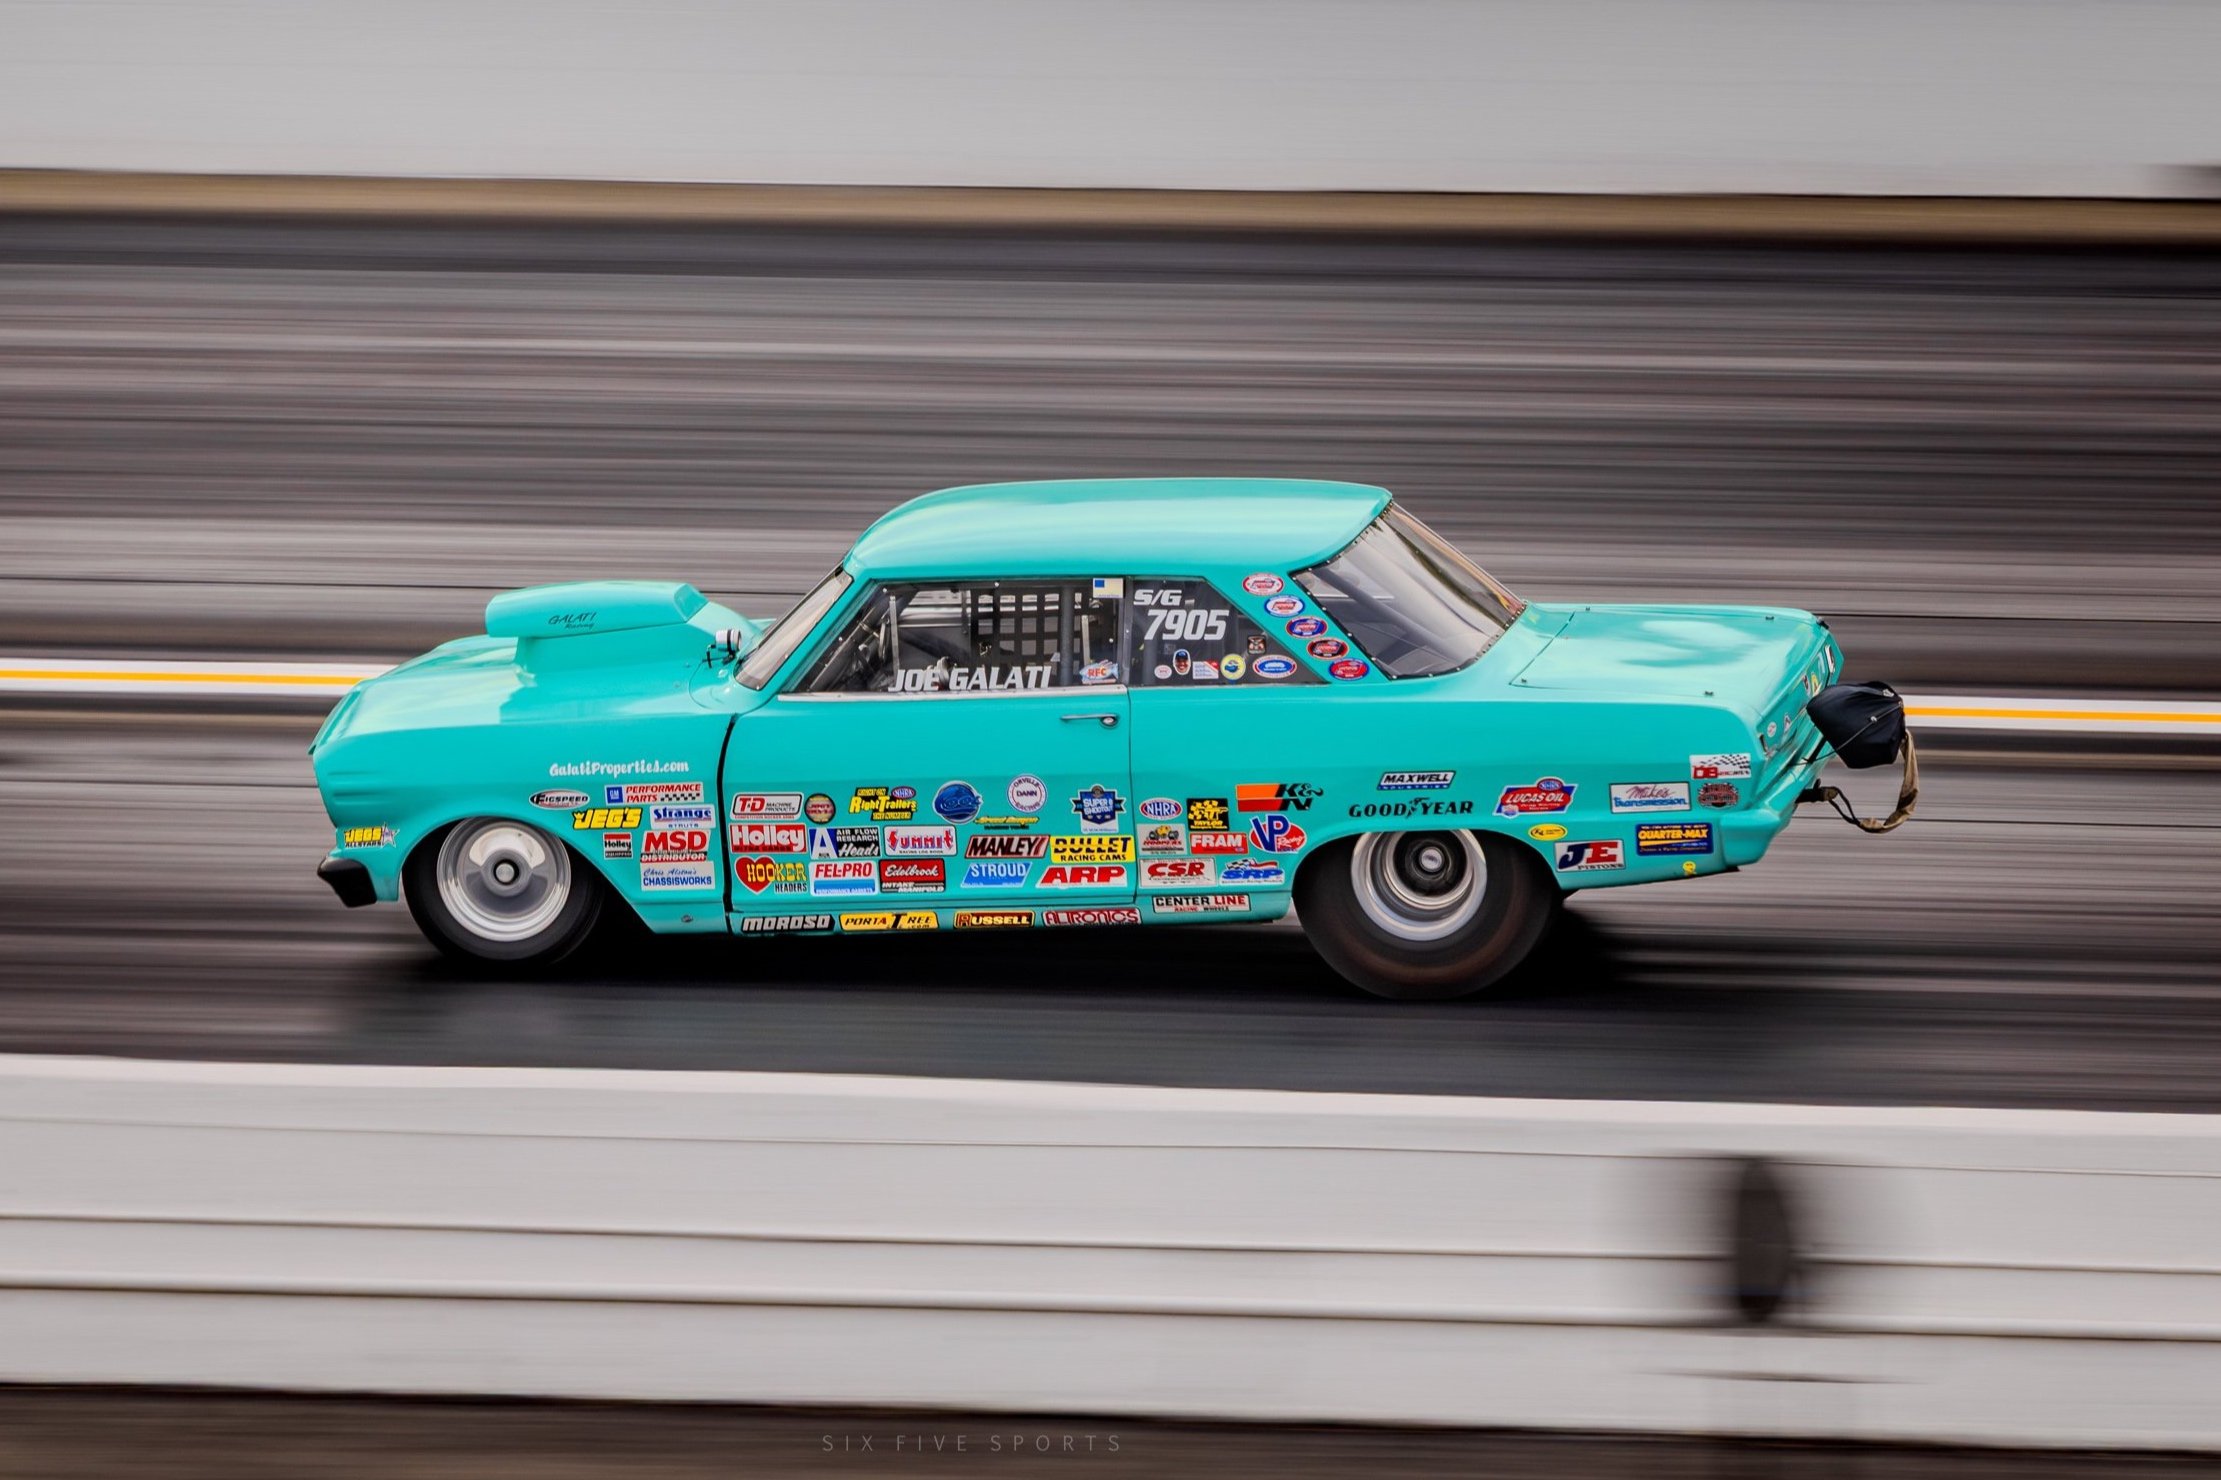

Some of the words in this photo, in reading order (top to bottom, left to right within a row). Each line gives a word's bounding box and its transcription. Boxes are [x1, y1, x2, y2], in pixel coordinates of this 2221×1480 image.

[1133, 589, 1182, 606] S/G
[548, 612, 597, 625] GALATI
[1144, 609, 1229, 641] 7905
[888, 667, 942, 692] JOE
[949, 666, 1052, 690] GALATI
[1087, 668, 1107, 677] RFC
[549, 760, 690, 779] GalatiProperties.com
[1384, 773, 1450, 783] MAXWELL
[626, 783, 701, 794] PERFORMANCE
[626, 794, 658, 803] PARTS
[1505, 793, 1547, 804] LUCAS
[1546, 792, 1565, 803] OIL
[653, 807, 712, 820] Strange
[1146, 802, 1177, 816] NHRA
[572, 808, 642, 830] JEG'S
[732, 825, 804, 852] Holley
[836, 834, 878, 842] RESEARCH
[1251, 814, 1290, 853] VP
[1638, 828, 1708, 840] QUARTER-MAX
[604, 840, 632, 852] Holley
[644, 831, 707, 853] MSD
[968, 837, 1037, 857] MANLEY
[1054, 837, 1131, 854] BULLET
[1191, 835, 1243, 848] FRAM
[838, 843, 879, 857] Heads
[1559, 841, 1618, 870] JE
[641, 853, 706, 862] DISTRIBUTOR
[1060, 854, 1096, 862] RACING
[746, 863, 807, 882] HOOKER
[815, 862, 873, 878] FEL-PRO
[885, 864, 939, 877] Edelbrock
[971, 863, 1026, 877] STROUD
[1041, 866, 1125, 884] ARP
[1148, 862, 1205, 877] CSR
[643, 876, 712, 887] CHASSISWORKS
[775, 883, 807, 894] HEADERS
[1155, 896, 1210, 907] CENTER
[1214, 894, 1246, 905] LINE
[742, 914, 831, 932] MOROSO
[845, 917, 887, 926] PORTA
[957, 912, 1030, 927] RUSSELL
